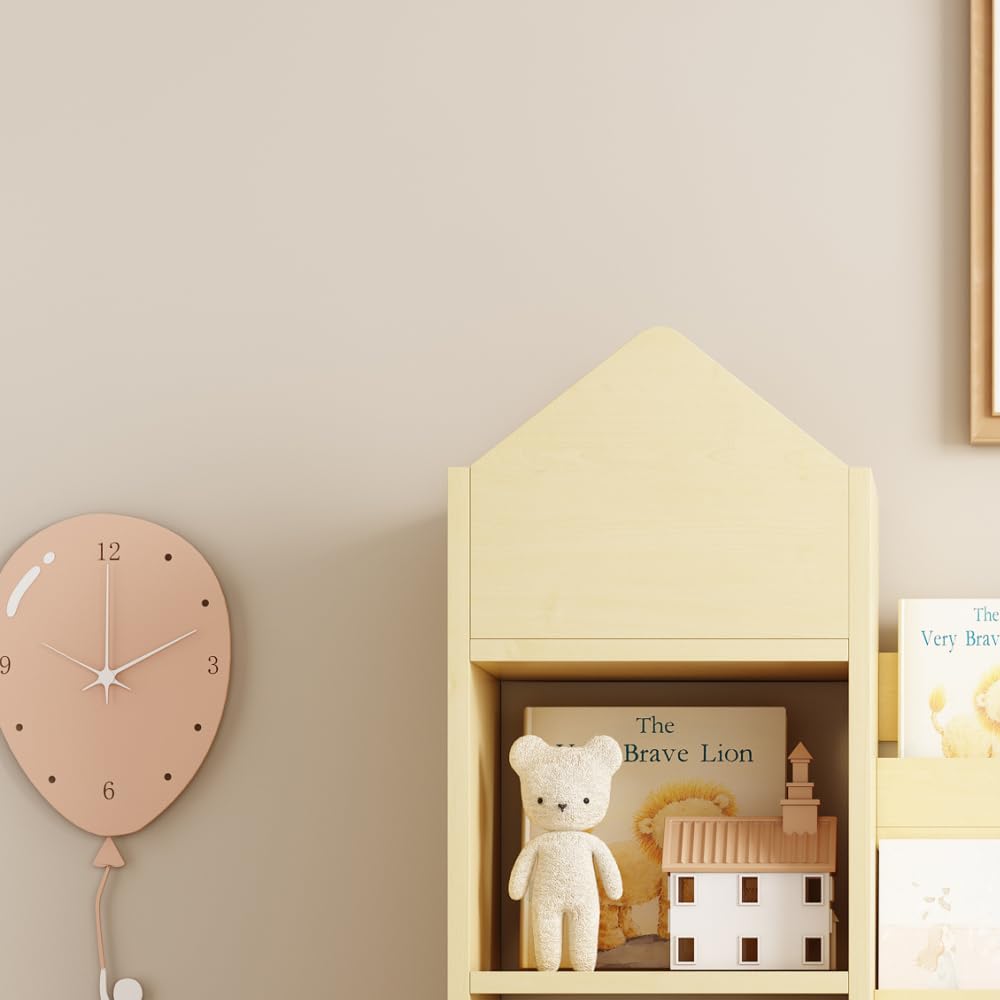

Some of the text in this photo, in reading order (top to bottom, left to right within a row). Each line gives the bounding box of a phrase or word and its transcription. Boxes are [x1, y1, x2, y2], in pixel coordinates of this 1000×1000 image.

[98, 542, 120, 561] 12
[974, 606, 999, 622] The
[921, 630, 957, 653] Very
[0, 656, 11, 675] 9
[207, 655, 219, 675] 3
[635, 716, 675, 734] The
[624, 743, 754, 763] Brave Lion
[102, 781, 115, 800] 6
